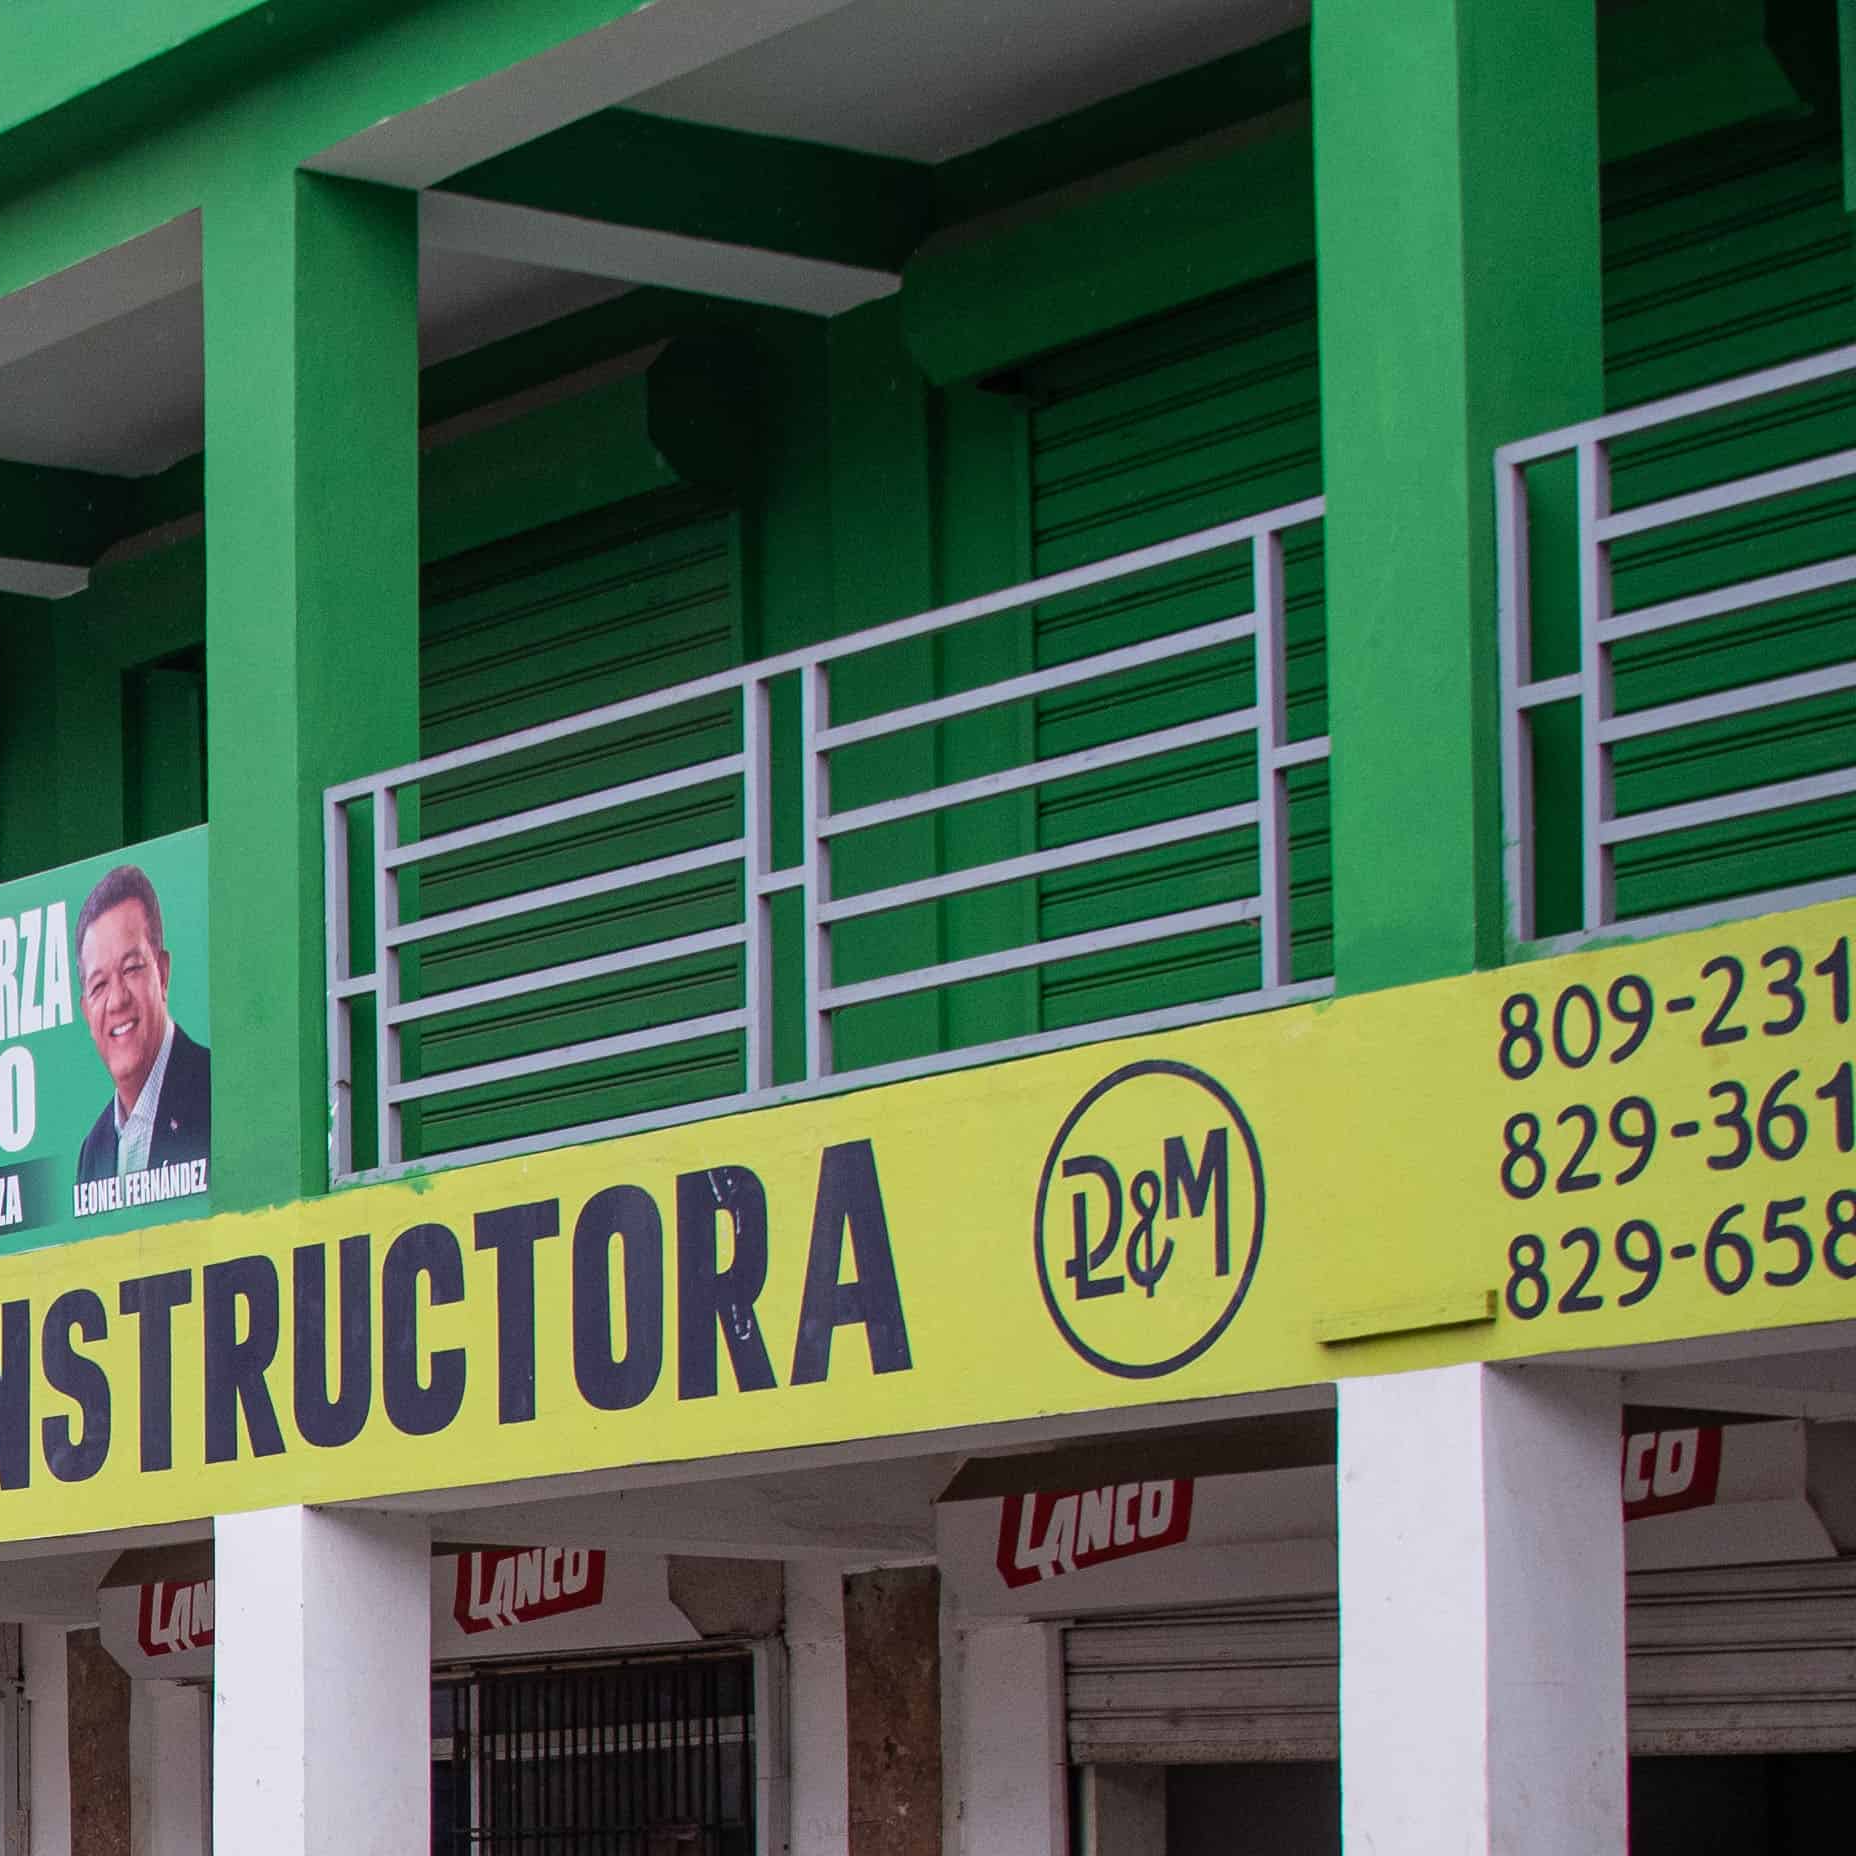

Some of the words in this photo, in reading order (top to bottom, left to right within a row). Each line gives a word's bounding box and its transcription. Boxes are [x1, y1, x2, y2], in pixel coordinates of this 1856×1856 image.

[1498, 935, 1851, 1080] 809-231
[73, 1176, 123, 1217] LEONEL
[125, 1157, 208, 1208] FERNÁNDEZ
[1500, 1062, 1856, 1200] 829-361
[1505, 1189, 1856, 1321] 829-658
[1014, 1478, 1174, 1580] LANCO
[468, 1547, 589, 1632] LANCO
